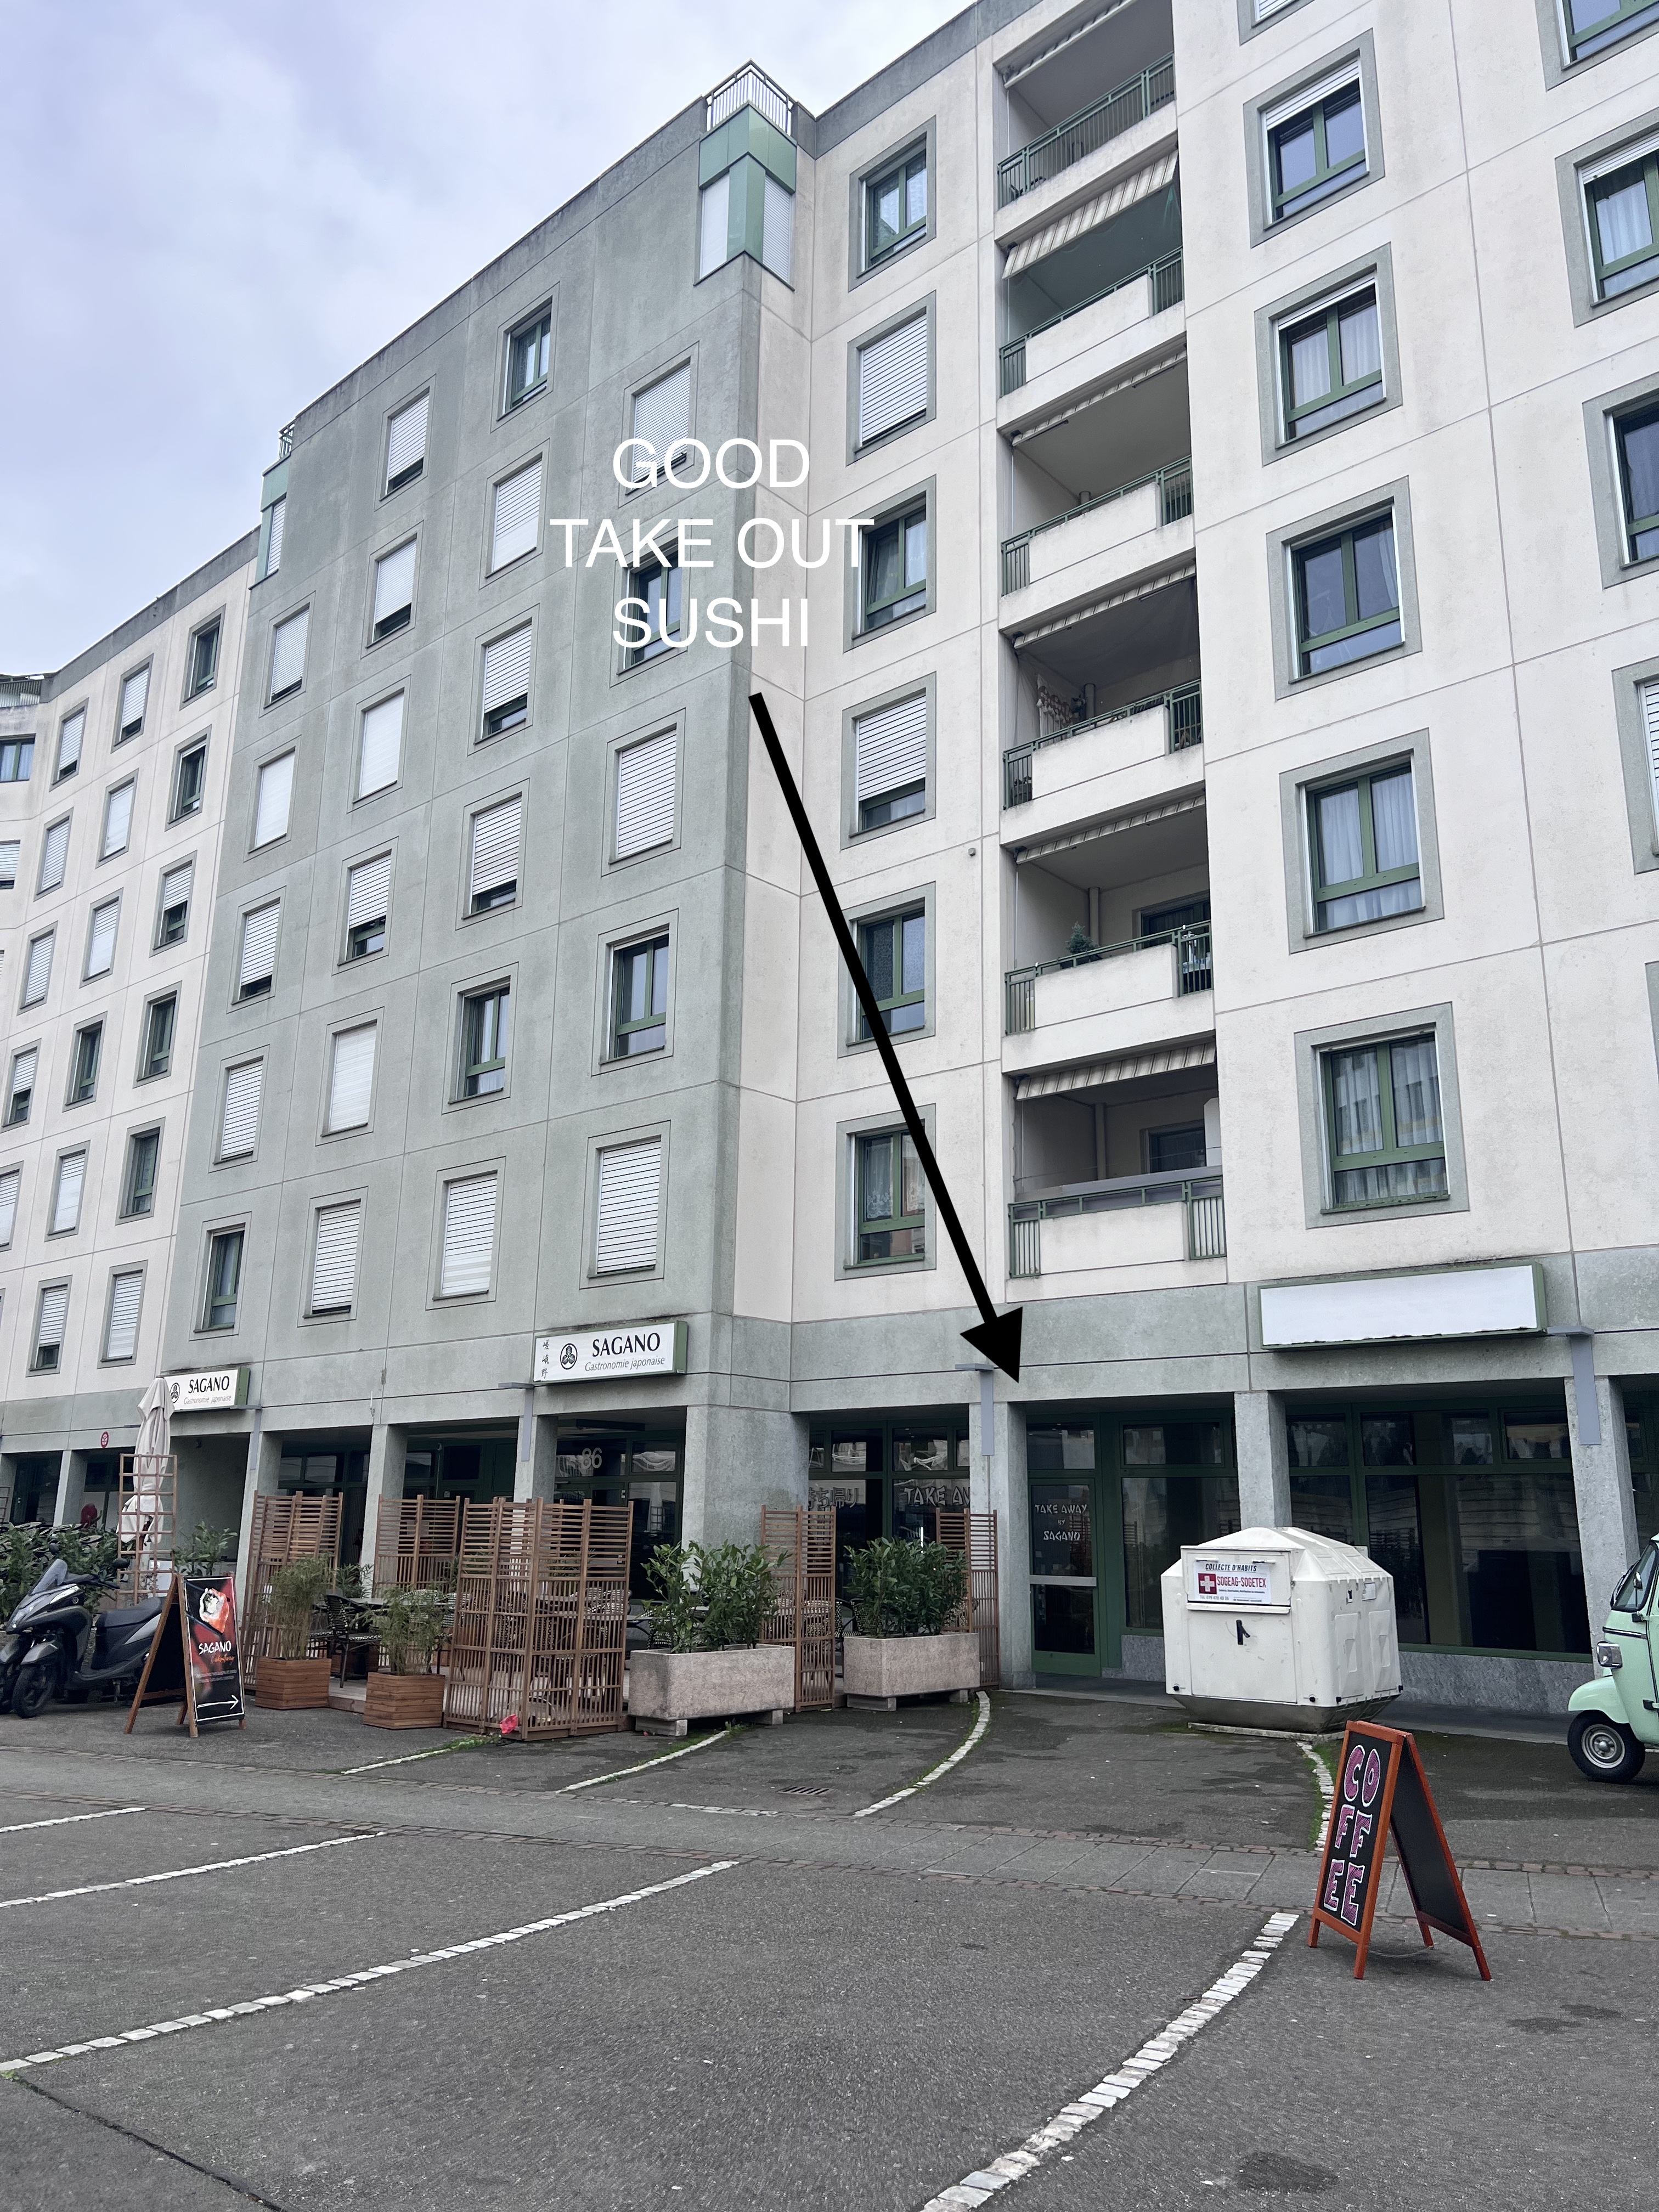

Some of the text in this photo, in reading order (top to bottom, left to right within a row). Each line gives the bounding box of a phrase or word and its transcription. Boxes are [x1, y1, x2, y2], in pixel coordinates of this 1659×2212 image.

[592, 1333, 661, 1357] SAGANO
[585, 1355, 665, 1372] Gastronomie japonaise
[188, 1375, 230, 1393] SAGANO
[211, 1395, 232, 1404] japonaise
[582, 1447, 602, 1470] 86
[904, 1485, 946, 1507] TAKE
[1035, 1504, 1087, 1514] TAKE AWAY
[1043, 1531, 1081, 1542] SAGANO
[1205, 1563, 1231, 1571] COLLECTE
[1217, 1576, 1267, 1588] SOGEAG-SOGETEX
[198, 1640, 232, 1655] SAGANO
